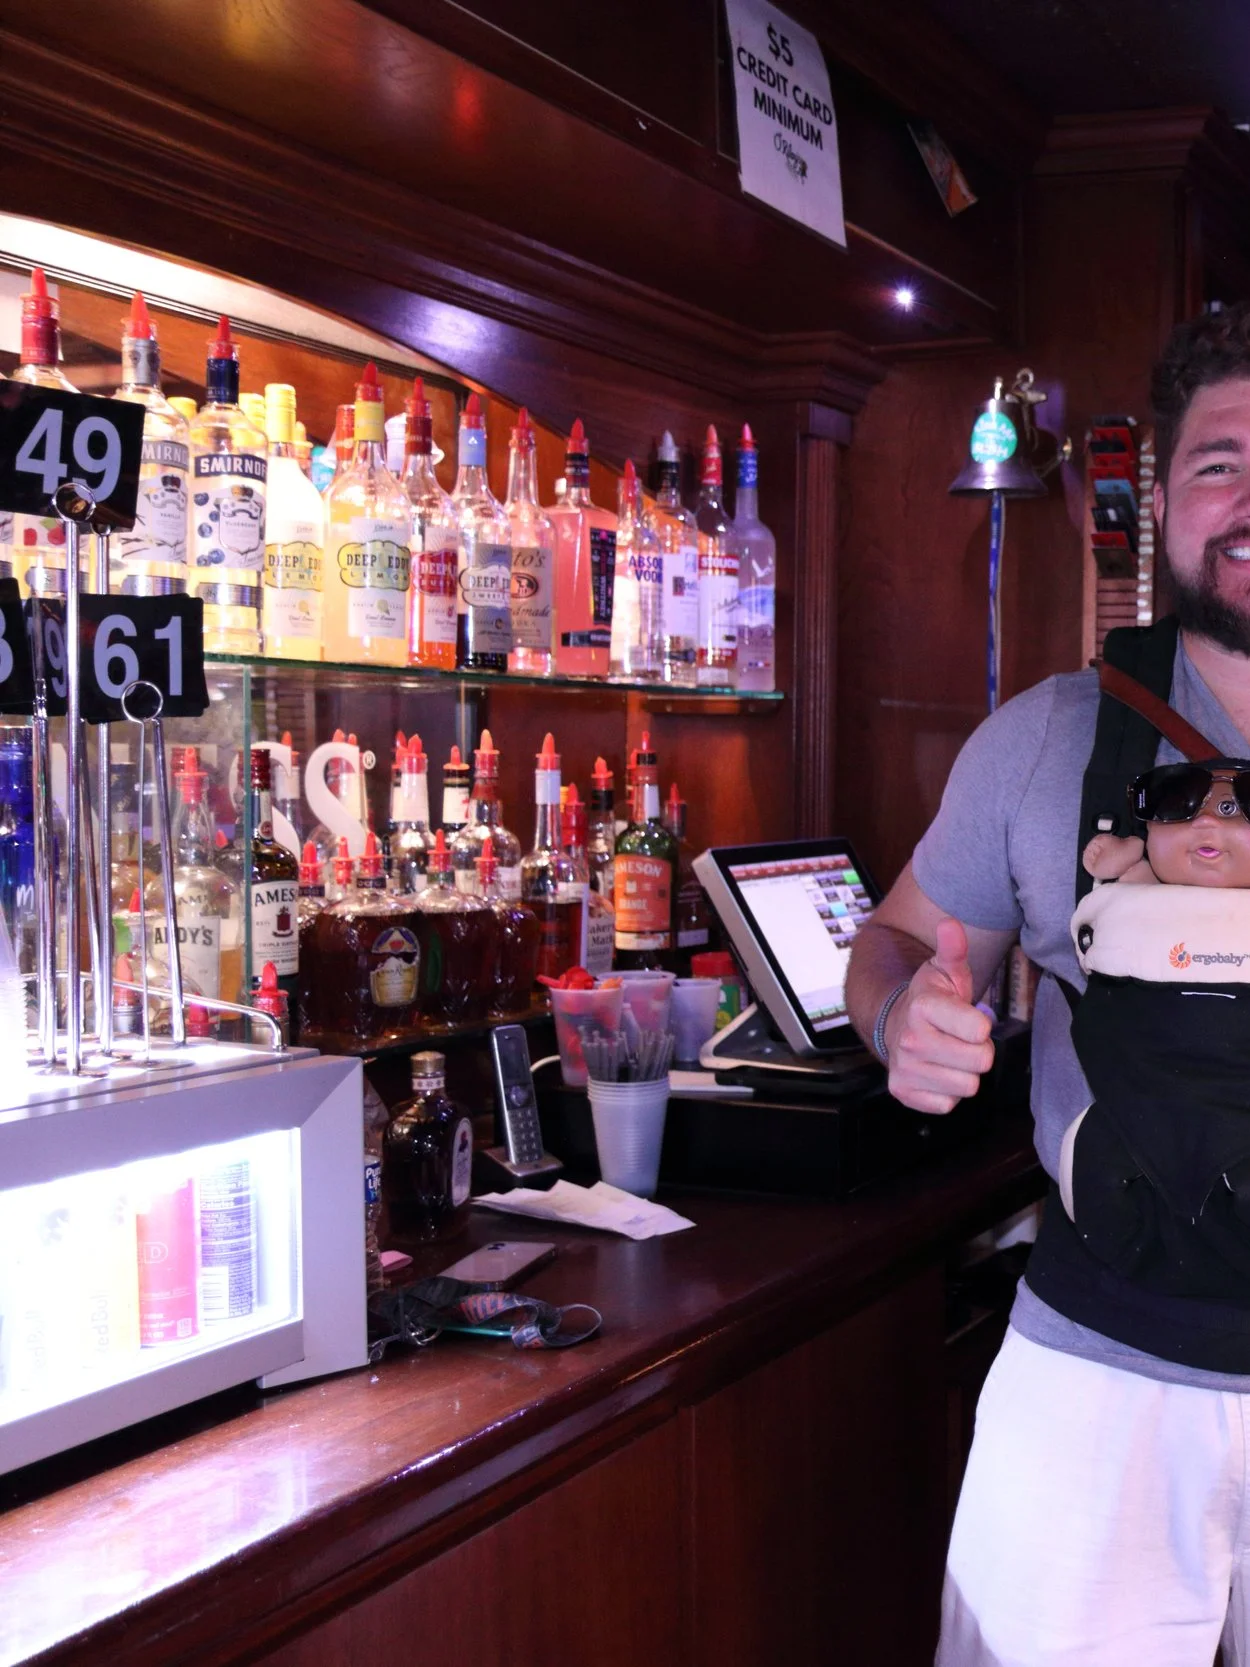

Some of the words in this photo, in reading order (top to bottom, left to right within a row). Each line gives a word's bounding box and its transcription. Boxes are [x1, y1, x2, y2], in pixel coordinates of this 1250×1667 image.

[767, 22, 794, 67] $5
[737, 46, 788, 96] CREDIT
[792, 85, 832, 125] CARD
[754, 87, 823, 150] MINIMUM
[15, 408, 122, 502] 49
[200, 456, 266, 477] SMIRNOF
[268, 554, 299, 568] DEEP
[346, 554, 377, 567] DEEP
[94, 614, 183, 698] 61
[254, 888, 298, 907] AMES
[155, 925, 214, 946] ADY'S
